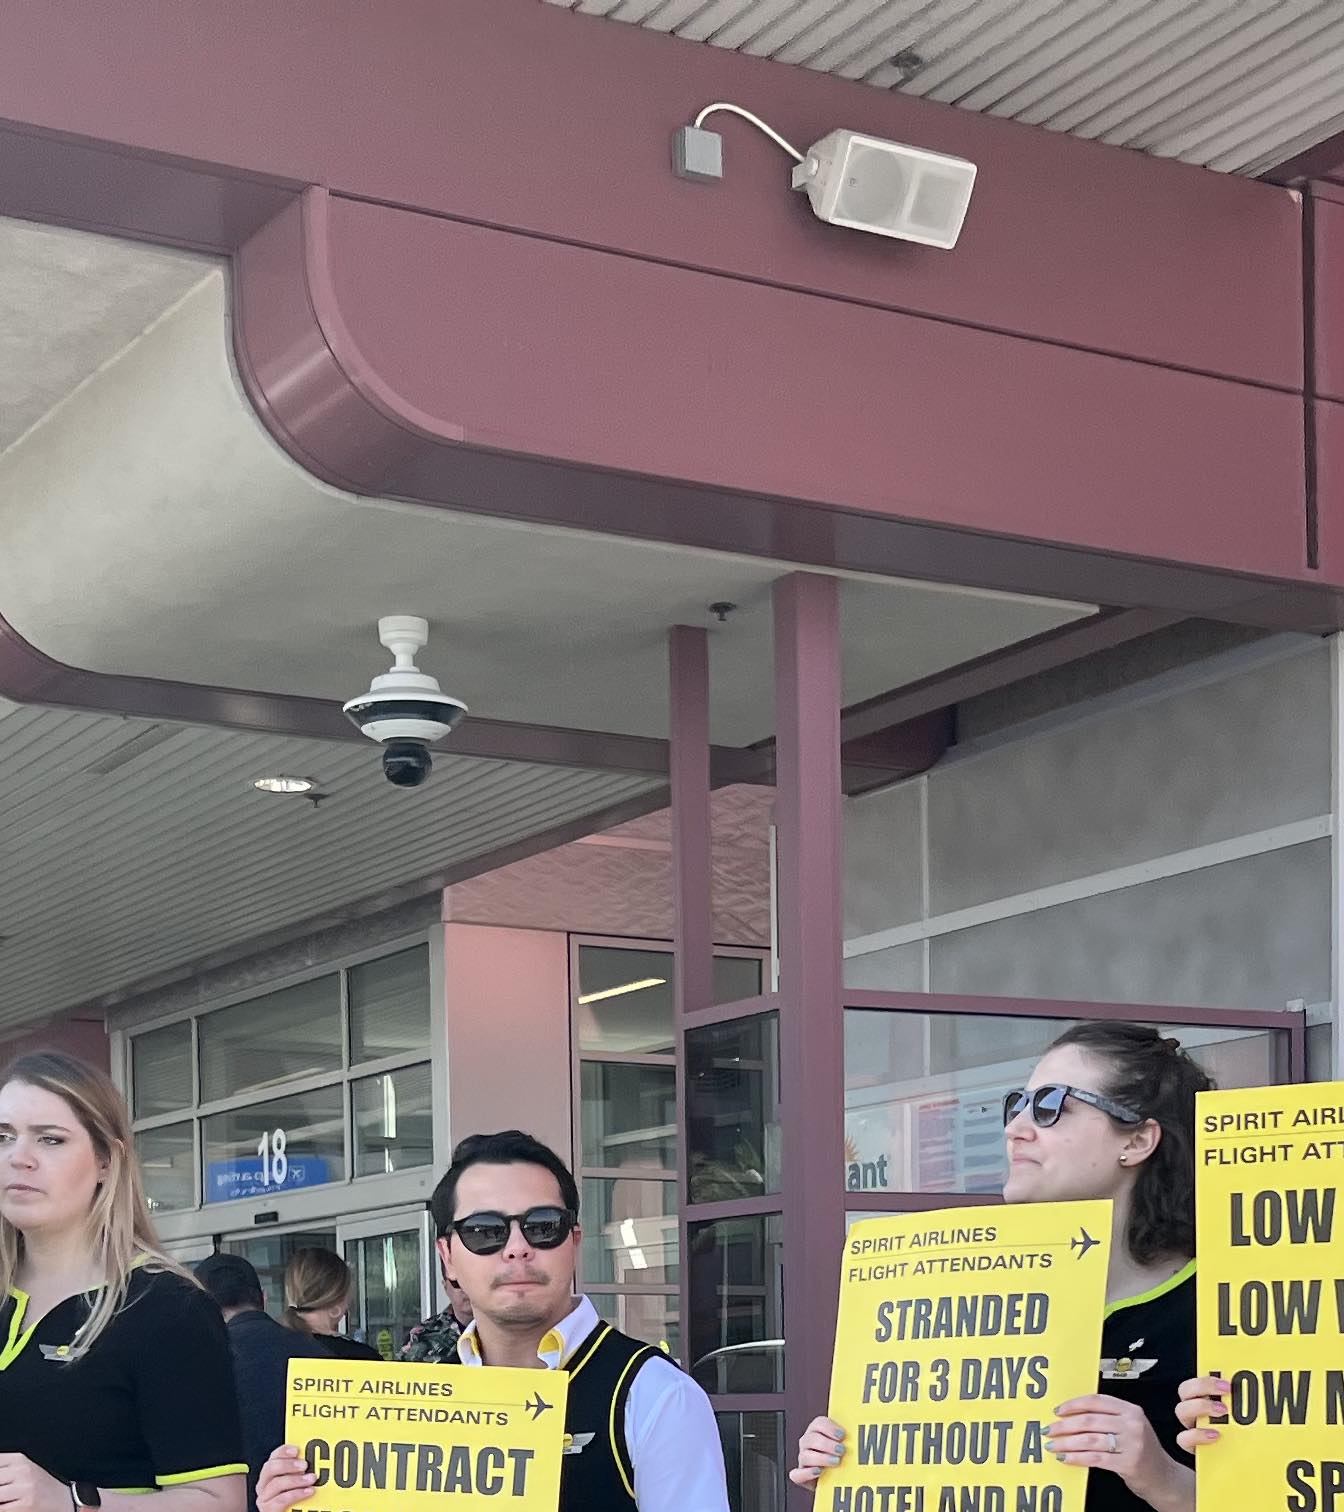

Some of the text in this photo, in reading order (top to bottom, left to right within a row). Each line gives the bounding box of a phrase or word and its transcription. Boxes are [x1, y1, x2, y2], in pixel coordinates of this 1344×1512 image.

[1204, 1110, 1284, 1133] SPIRIT
[258, 1128, 288, 1186] 18
[1204, 1142, 1294, 1166] FLIGHT
[1229, 1187, 1336, 1248] LOW
[850, 1226, 997, 1256] SPIRIT AIRLINES
[848, 1252, 1053, 1284] FLIGHT ATTENDANTS
[875, 1292, 1050, 1342] STRANDED
[1217, 1279, 1322, 1337] LOW
[292, 1377, 453, 1397] SPIRIT AIRLINES
[861, 1355, 1049, 1404] FOR 3 DAYS
[292, 1404, 509, 1426] FLIGHT ATTENDANTS
[857, 1420, 1043, 1466] WITHOUT A
[304, 1437, 535, 1497] CONTRACT
